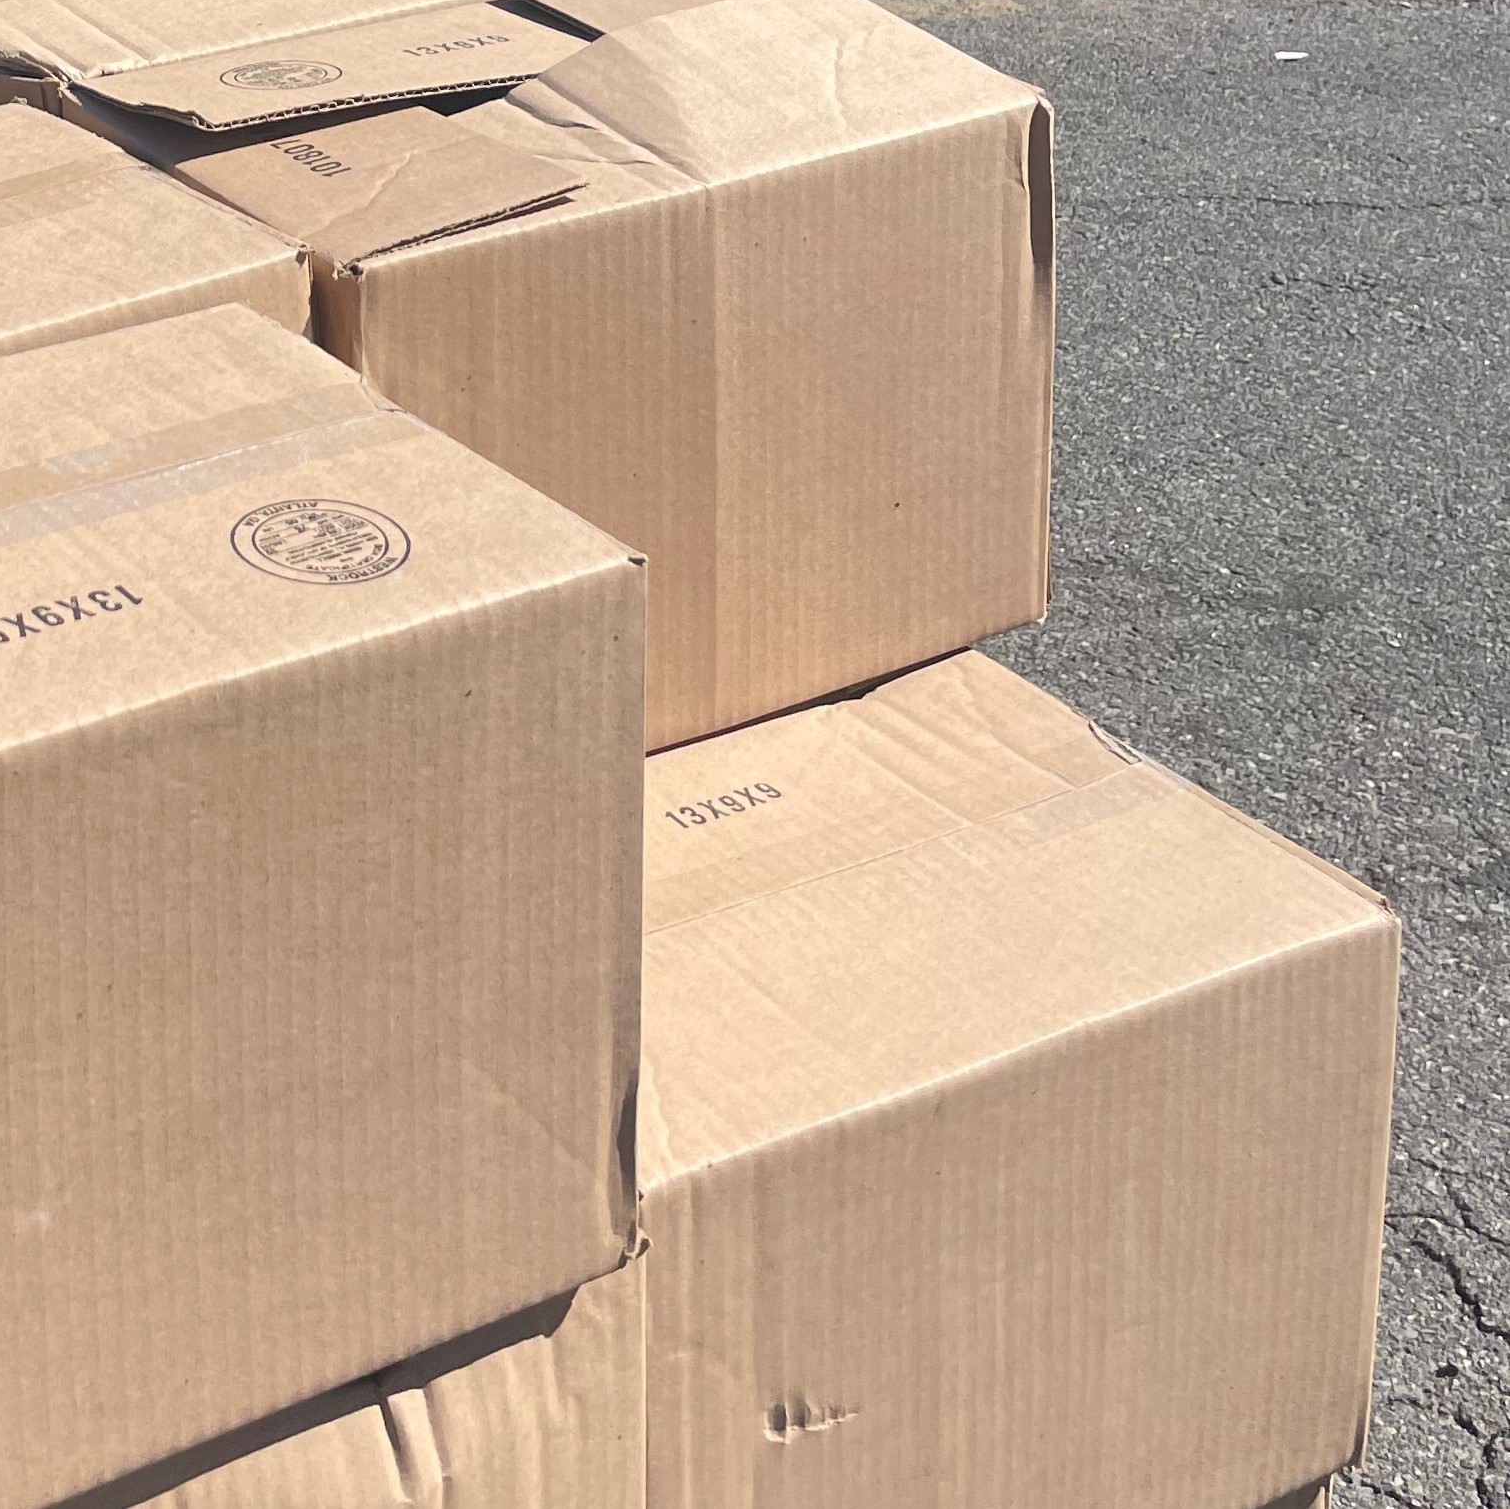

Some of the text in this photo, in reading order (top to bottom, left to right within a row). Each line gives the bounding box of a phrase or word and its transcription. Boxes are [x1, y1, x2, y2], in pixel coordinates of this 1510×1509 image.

[402, 33, 511, 58] 13X9X9
[270, 138, 352, 178] 101807
[664, 782, 782, 829] 13X9X9
